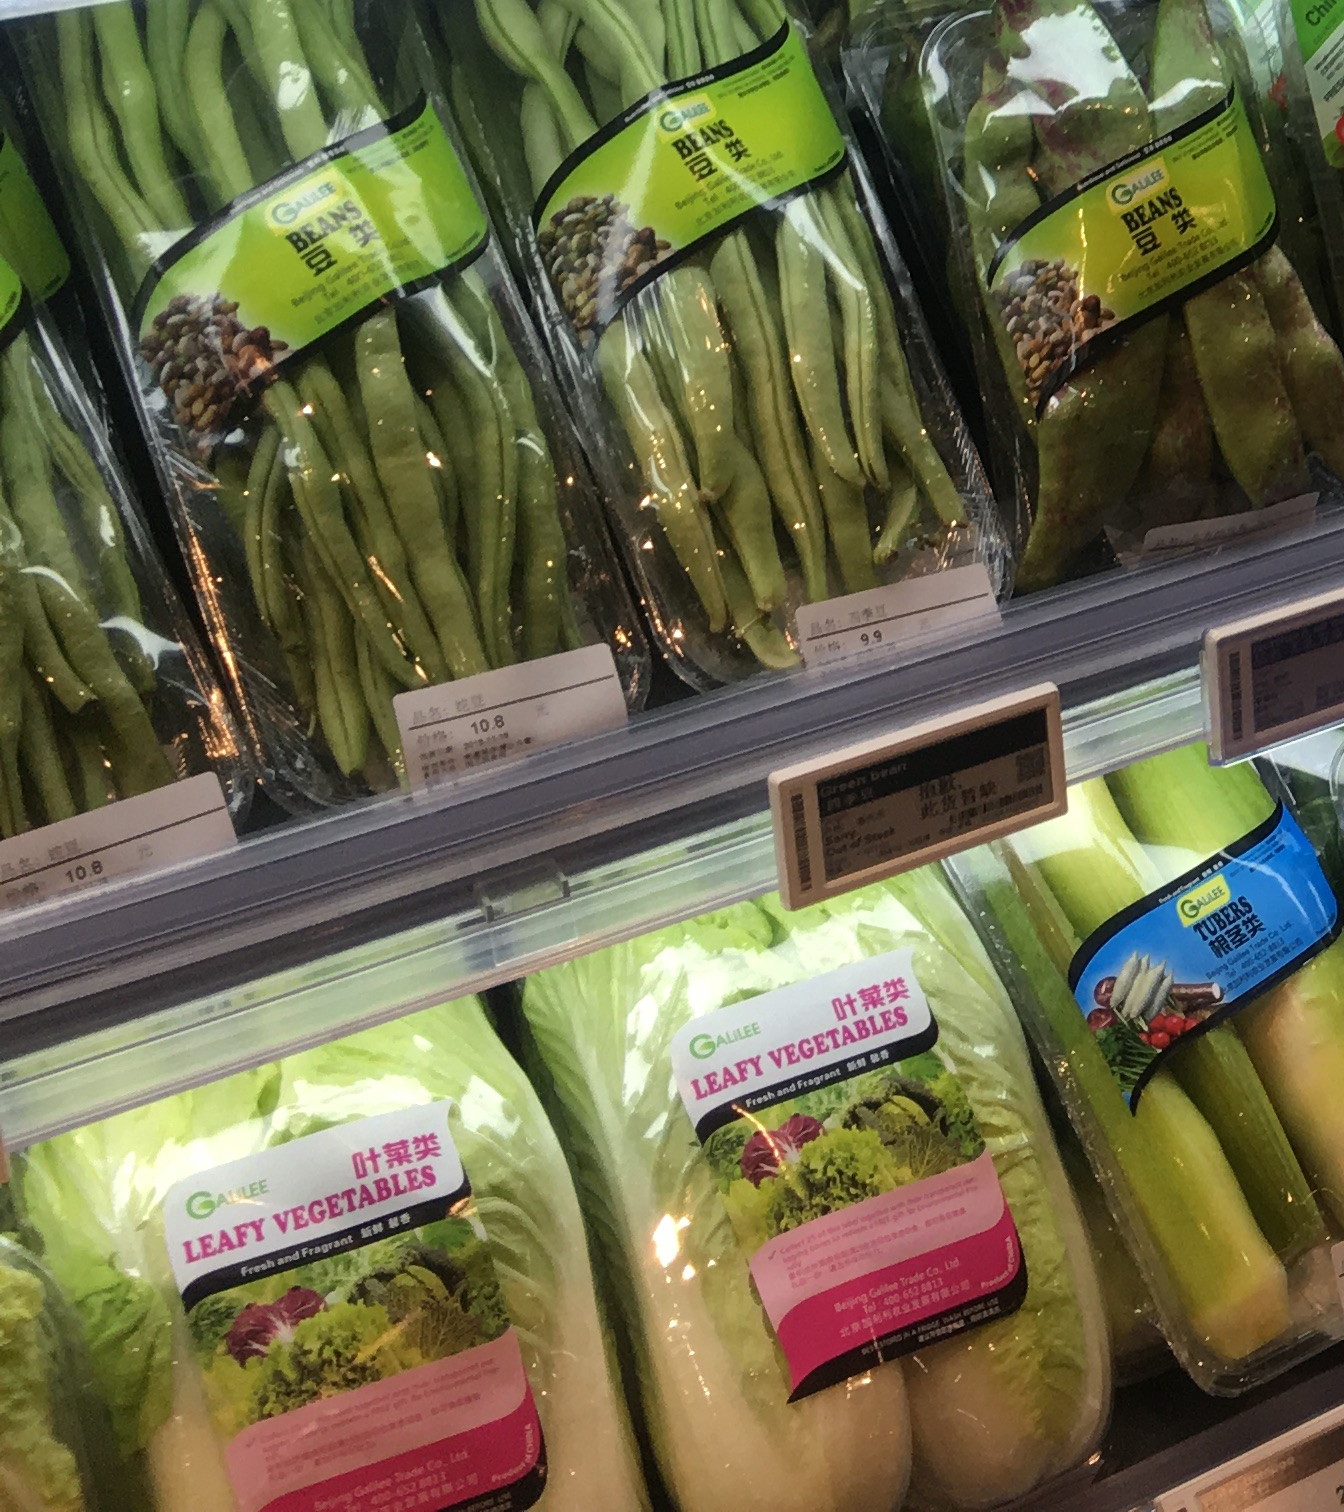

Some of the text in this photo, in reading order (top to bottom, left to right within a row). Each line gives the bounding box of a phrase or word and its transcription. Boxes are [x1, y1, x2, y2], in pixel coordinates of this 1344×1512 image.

[672, 118, 735, 160] BEANS
[684, 138, 752, 183] 豆类
[285, 199, 362, 253] BEANS
[1120, 186, 1183, 234] BEANS
[1131, 206, 1199, 256] 豆类
[860, 629, 883, 646] 9.9
[470, 714, 505, 734] 10.8
[818, 760, 908, 798] Green bean
[65, 860, 104, 883] 10.8
[1180, 885, 1226, 919] GALILEE
[1193, 895, 1253, 942] TUBERS
[831, 976, 911, 1022] 叶菜类
[688, 1021, 762, 1060] GALILEE
[690, 1005, 909, 1101] LEAFY VEGETABLES
[745, 1066, 842, 1108] Fresh and Fragrant
[350, 1131, 442, 1180] 叶菜类
[182, 1164, 438, 1265] LEAFY VEGETABLES
[240, 1234, 355, 1278] Fresh and Fragrant
